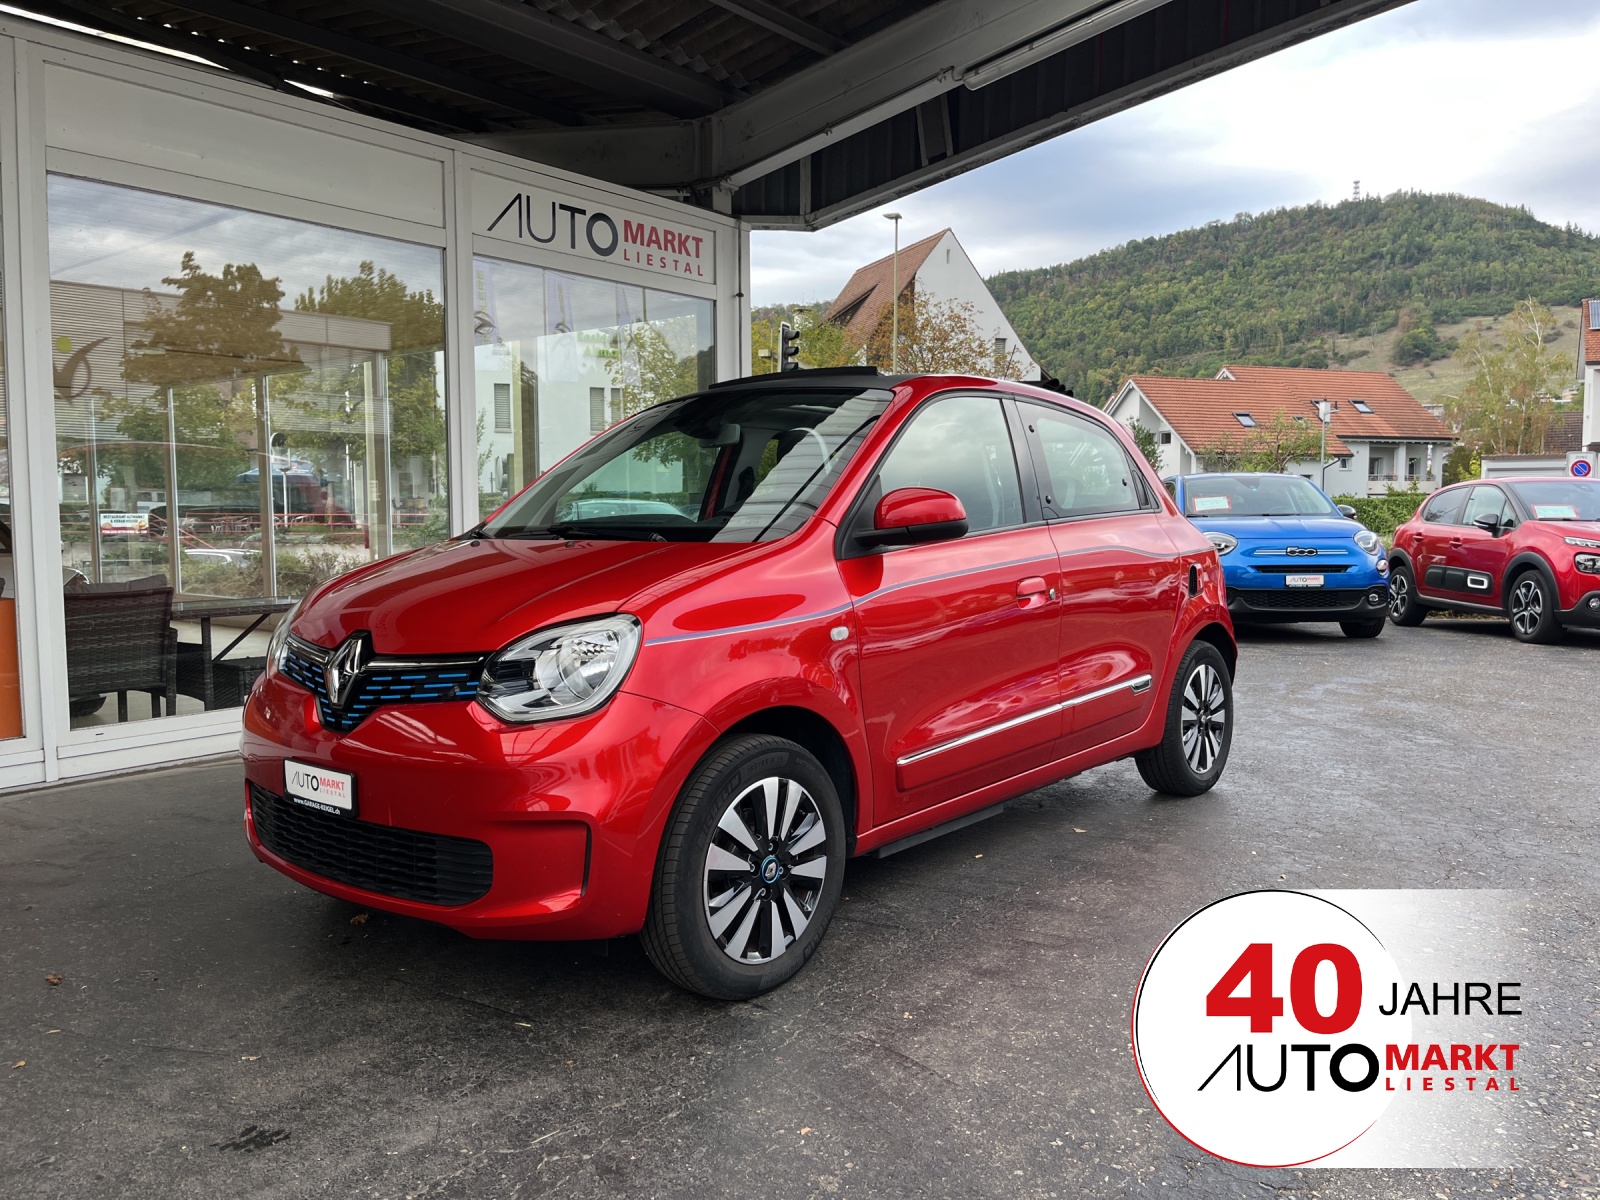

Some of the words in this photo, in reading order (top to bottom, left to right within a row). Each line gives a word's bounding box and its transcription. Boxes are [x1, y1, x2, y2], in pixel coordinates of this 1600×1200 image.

[623, 248, 704, 277] LIESTAL
[1286, 546, 1317, 557] 500
[320, 787, 346, 799] LIESTAL
